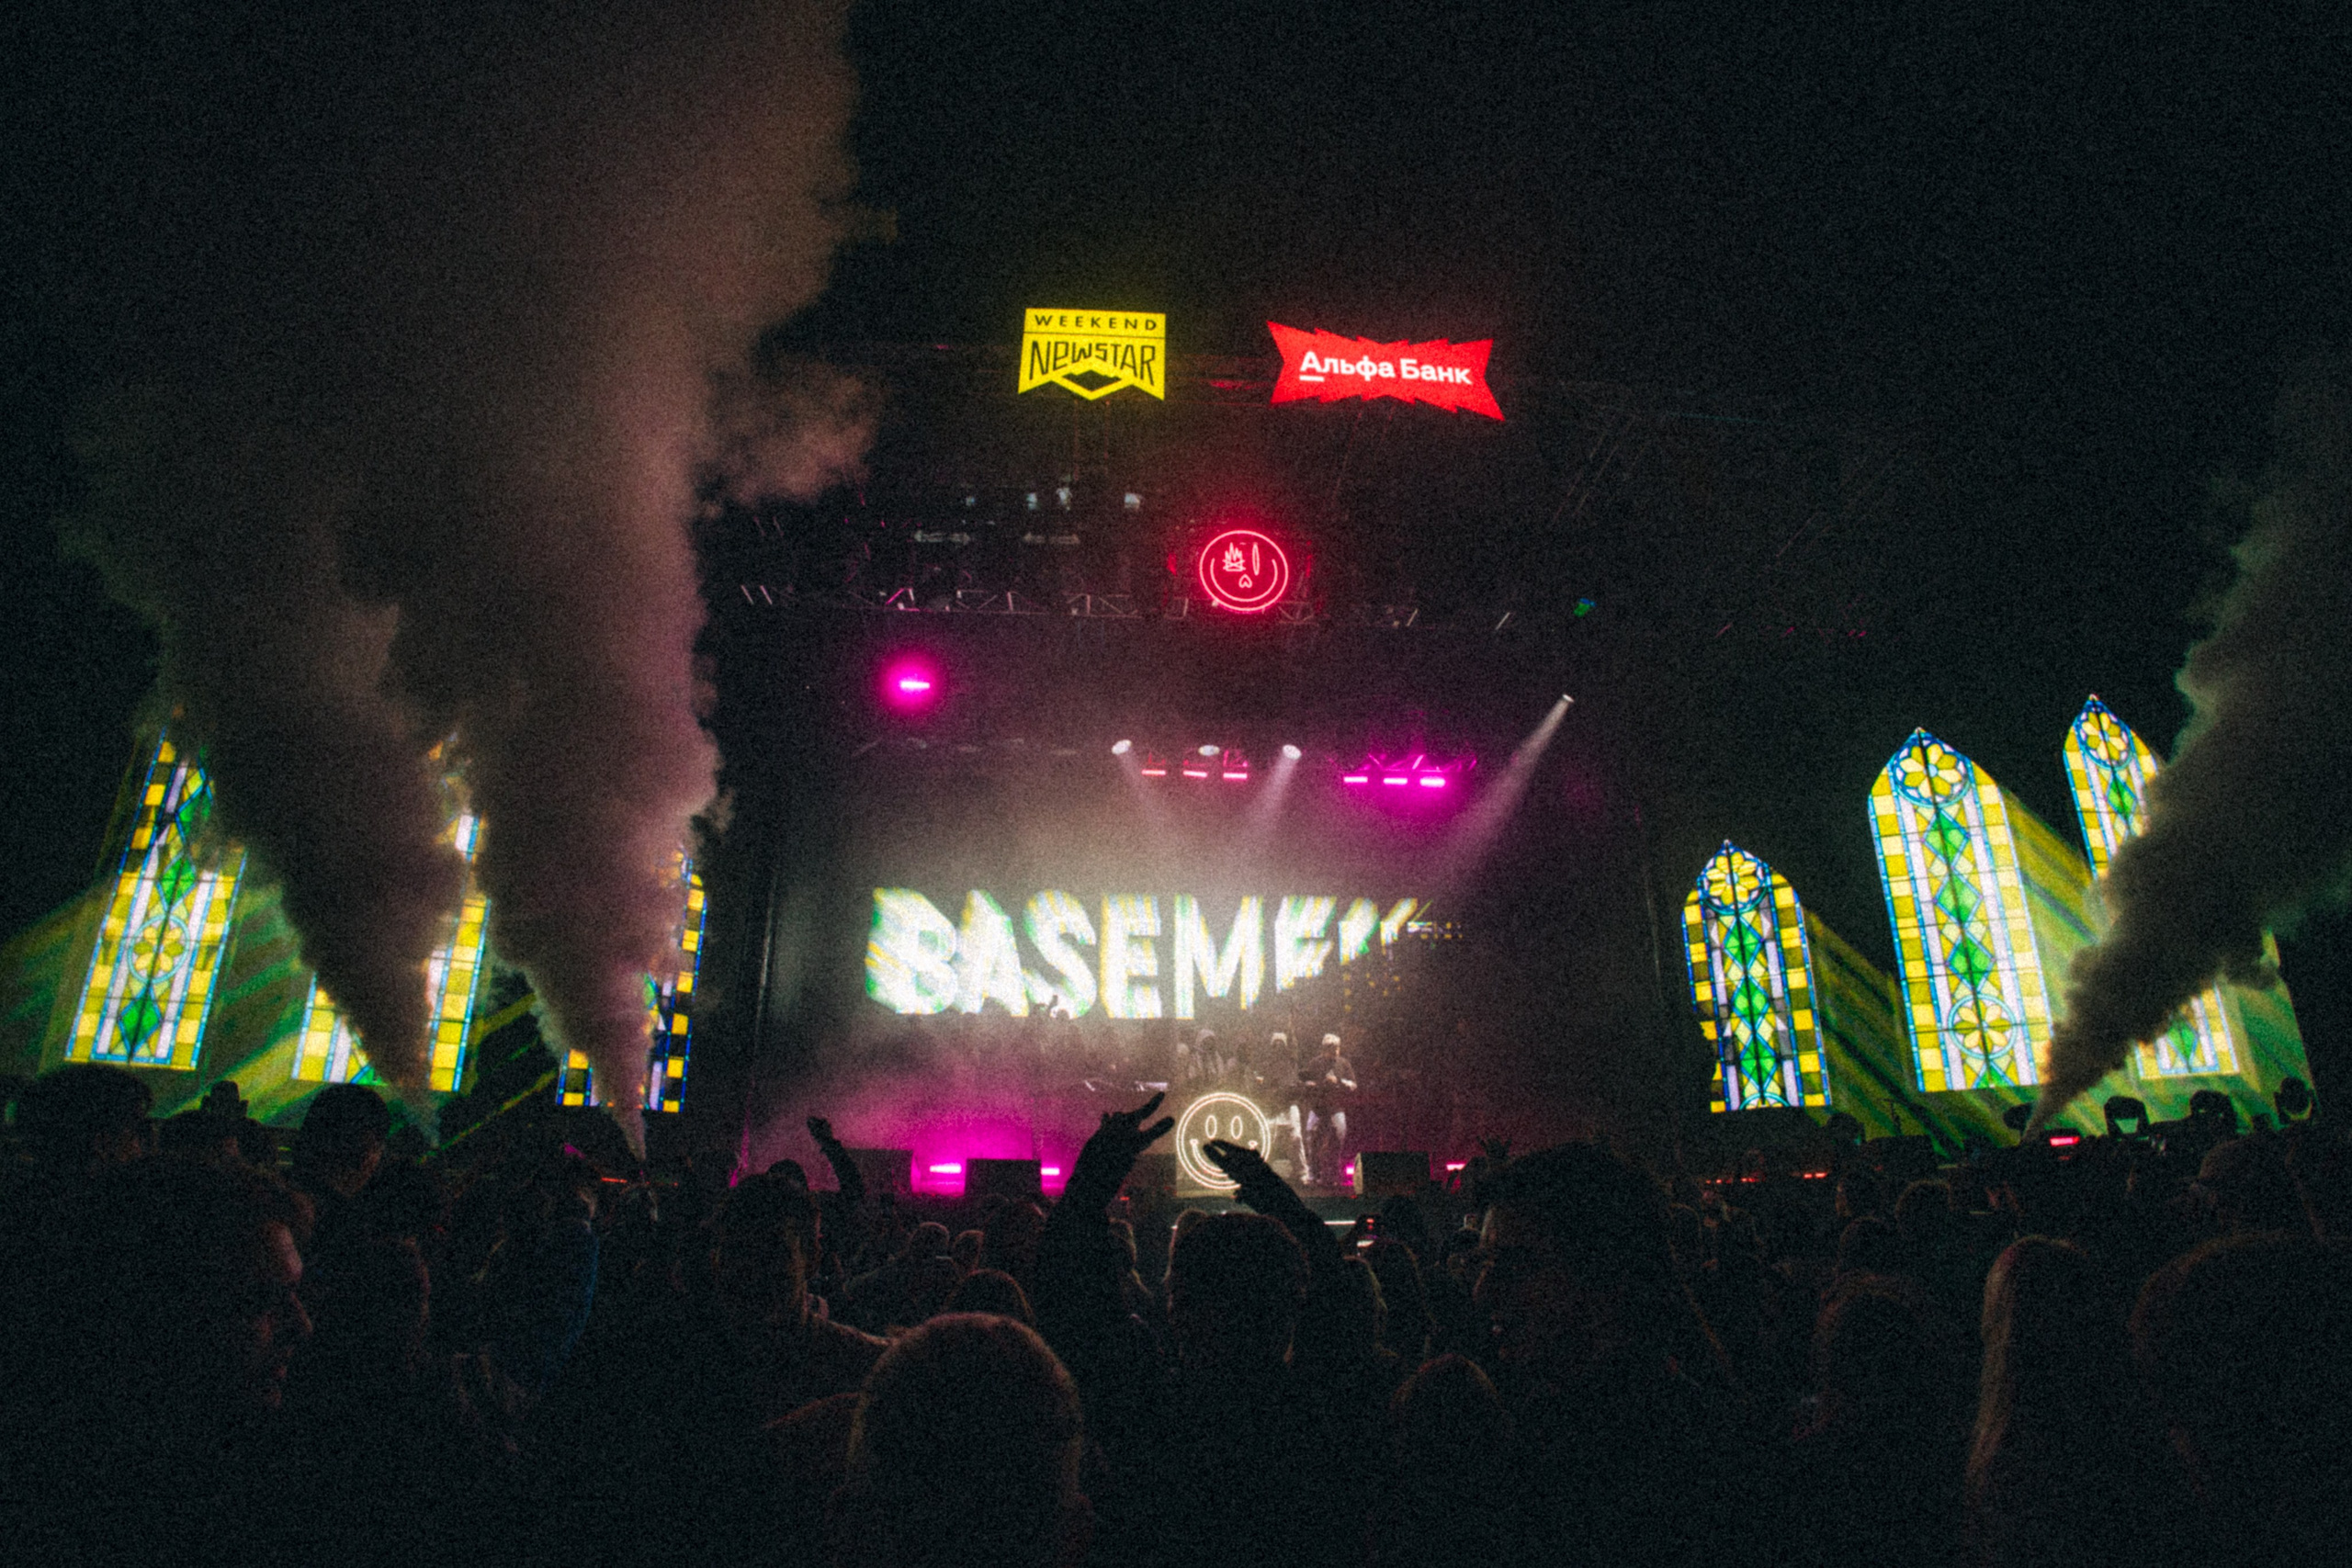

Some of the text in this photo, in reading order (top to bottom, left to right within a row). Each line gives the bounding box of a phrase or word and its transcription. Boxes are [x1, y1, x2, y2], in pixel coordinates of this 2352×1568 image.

[1035, 314, 1158, 331] WEEKEND
[1298, 351, 1473, 385] Альфа Банк
[864, 886, 1433, 1021] BASEME
